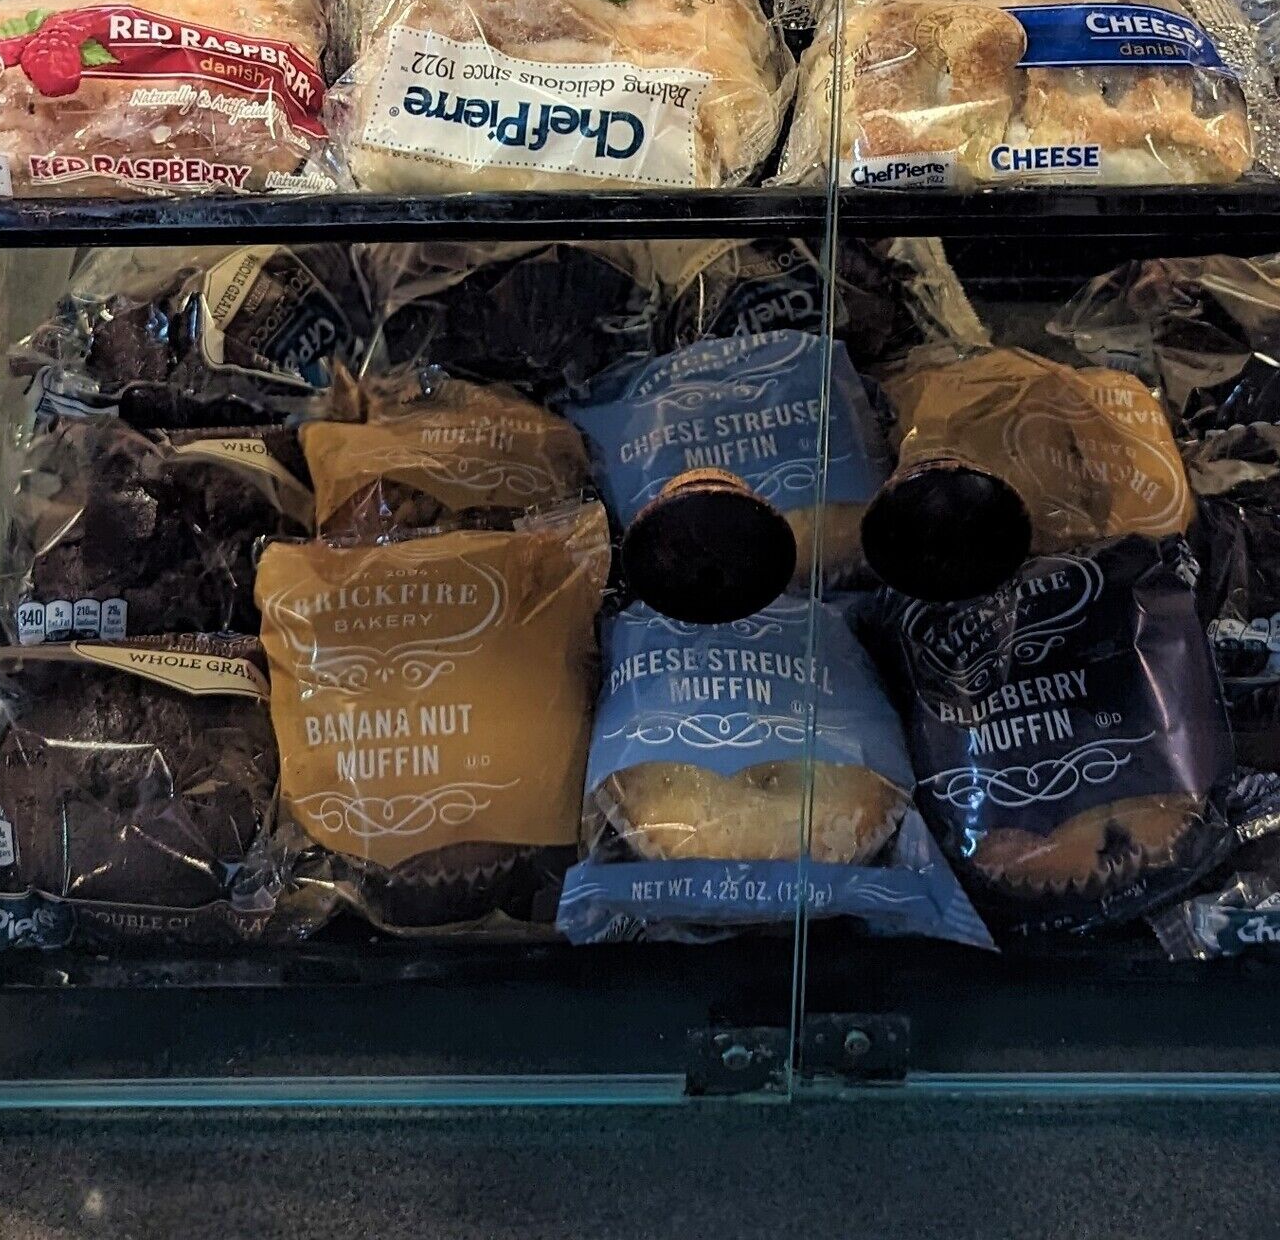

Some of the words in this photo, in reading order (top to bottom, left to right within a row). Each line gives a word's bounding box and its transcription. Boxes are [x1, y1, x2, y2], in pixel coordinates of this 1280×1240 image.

[1085, 10, 1201, 47] CHEESE
[109, 14, 173, 43] RED
[180, 28, 317, 106] RASPBERRY
[411, 50, 457, 79] 1922
[1120, 42, 1188, 58] danish
[198, 57, 269, 90] danish
[462, 62, 512, 84] since
[519, 69, 616, 95] delicious
[130, 88, 198, 114] Naturally
[622, 73, 690, 108] Baking
[402, 84, 645, 159] ChefPierre
[30, 157, 88, 179] RED
[92, 156, 252, 189] RASPBERRY
[850, 162, 946, 186] ChefPierre
[990, 144, 1100, 172] CHEESE
[619, 418, 708, 465] CHEESE
[683, 433, 779, 468] MUFFIN
[292, 582, 478, 616] BRICKFIRE
[19, 608, 43, 627] 340
[334, 613, 434, 633] BAKERY
[129, 652, 202, 670] WHOLE
[609, 647, 699, 696] CHEESE
[708, 648, 834, 697] STREUSEL
[669, 676, 773, 706] MUFFIN
[938, 668, 1088, 723] BLUEBERRY
[305, 708, 411, 746] BANANA
[420, 704, 473, 736] NUT
[969, 708, 1074, 756] MUFFIN
[336, 745, 440, 781] MUFFIN
[631, 880, 666, 902] NET
[667, 878, 698, 898] WT.
[702, 878, 740, 902] 4.25
[744, 881, 773, 903] OZ.
